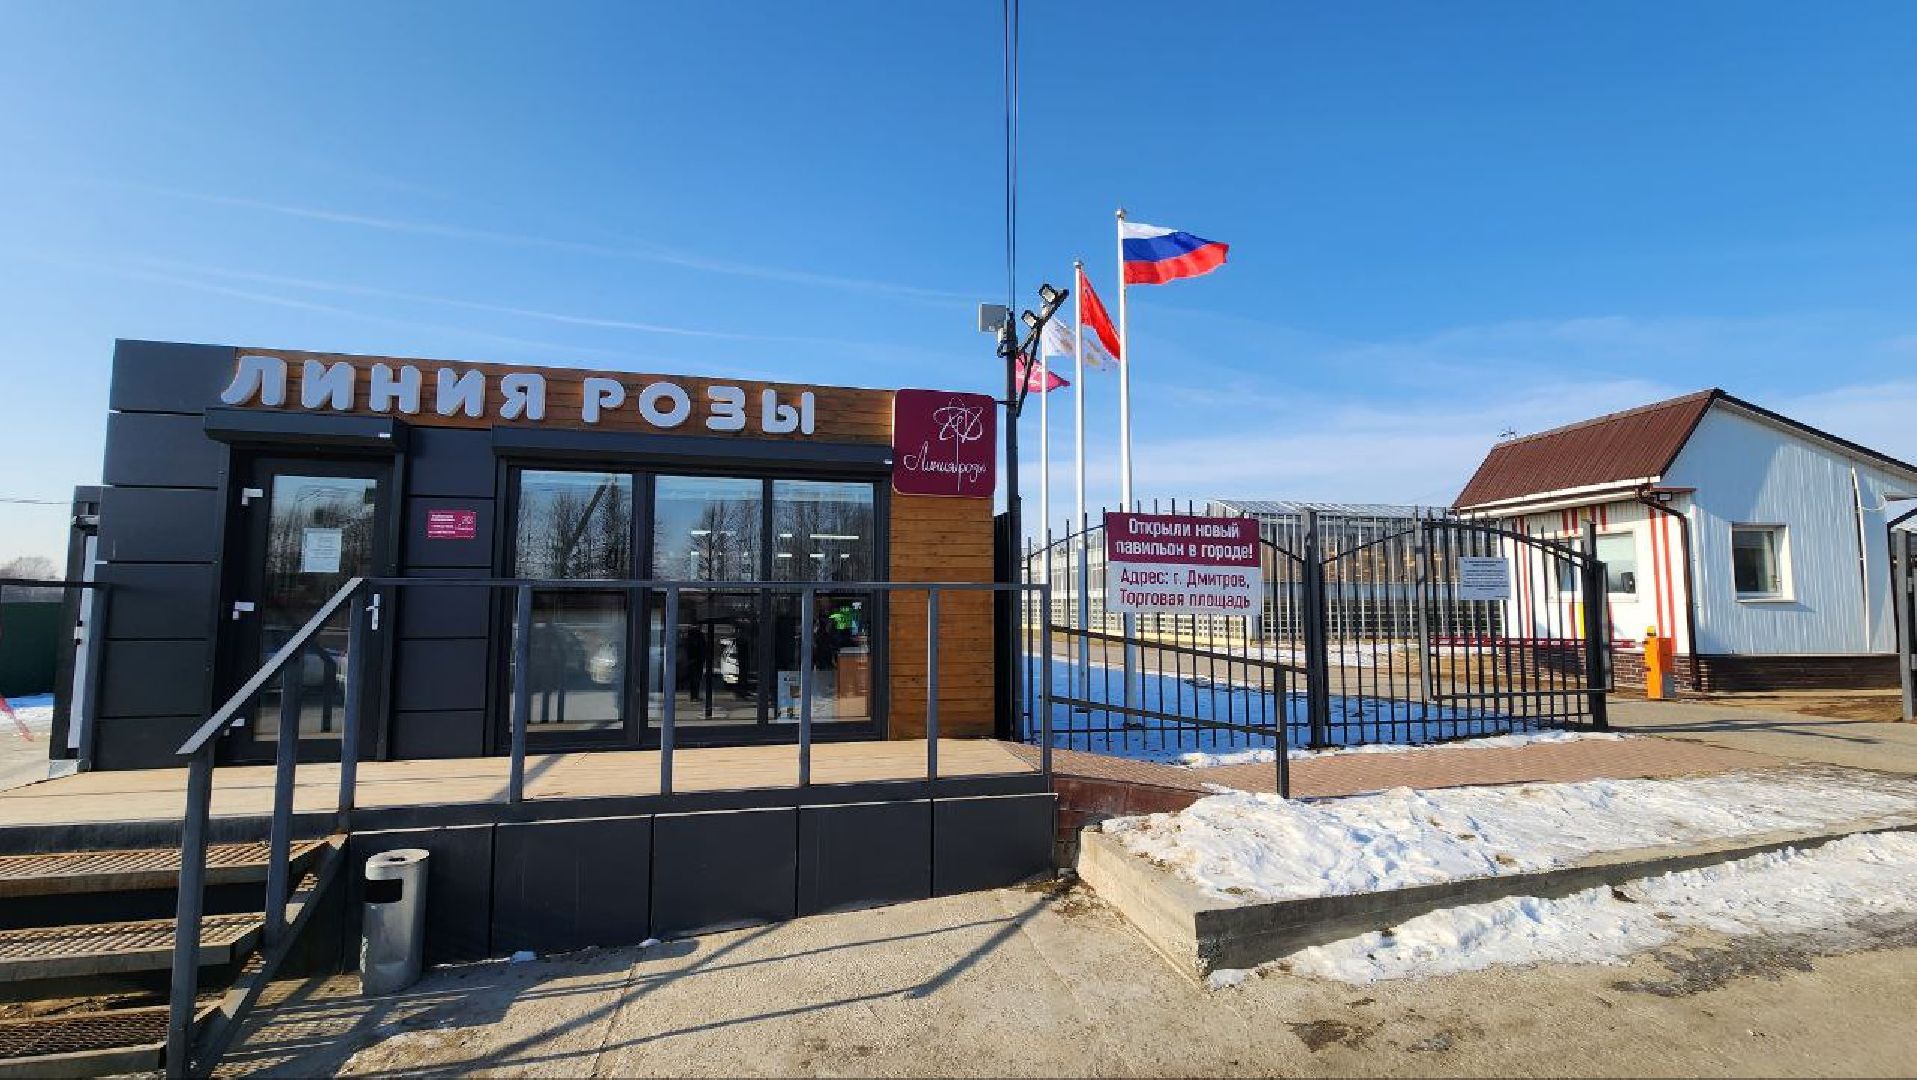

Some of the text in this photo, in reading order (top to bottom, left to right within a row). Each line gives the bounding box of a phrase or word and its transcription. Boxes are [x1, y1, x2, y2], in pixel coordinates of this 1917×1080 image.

[221, 355, 815, 435] ЛИНИЯ РОЗЫ
[1128, 518, 1239, 539] Открыли новый
[1116, 540, 1253, 561] павильон в городе!
[1120, 568, 1250, 589] Адрес: г. Дмитров,
[1120, 589, 1251, 609] Торговая площадь
